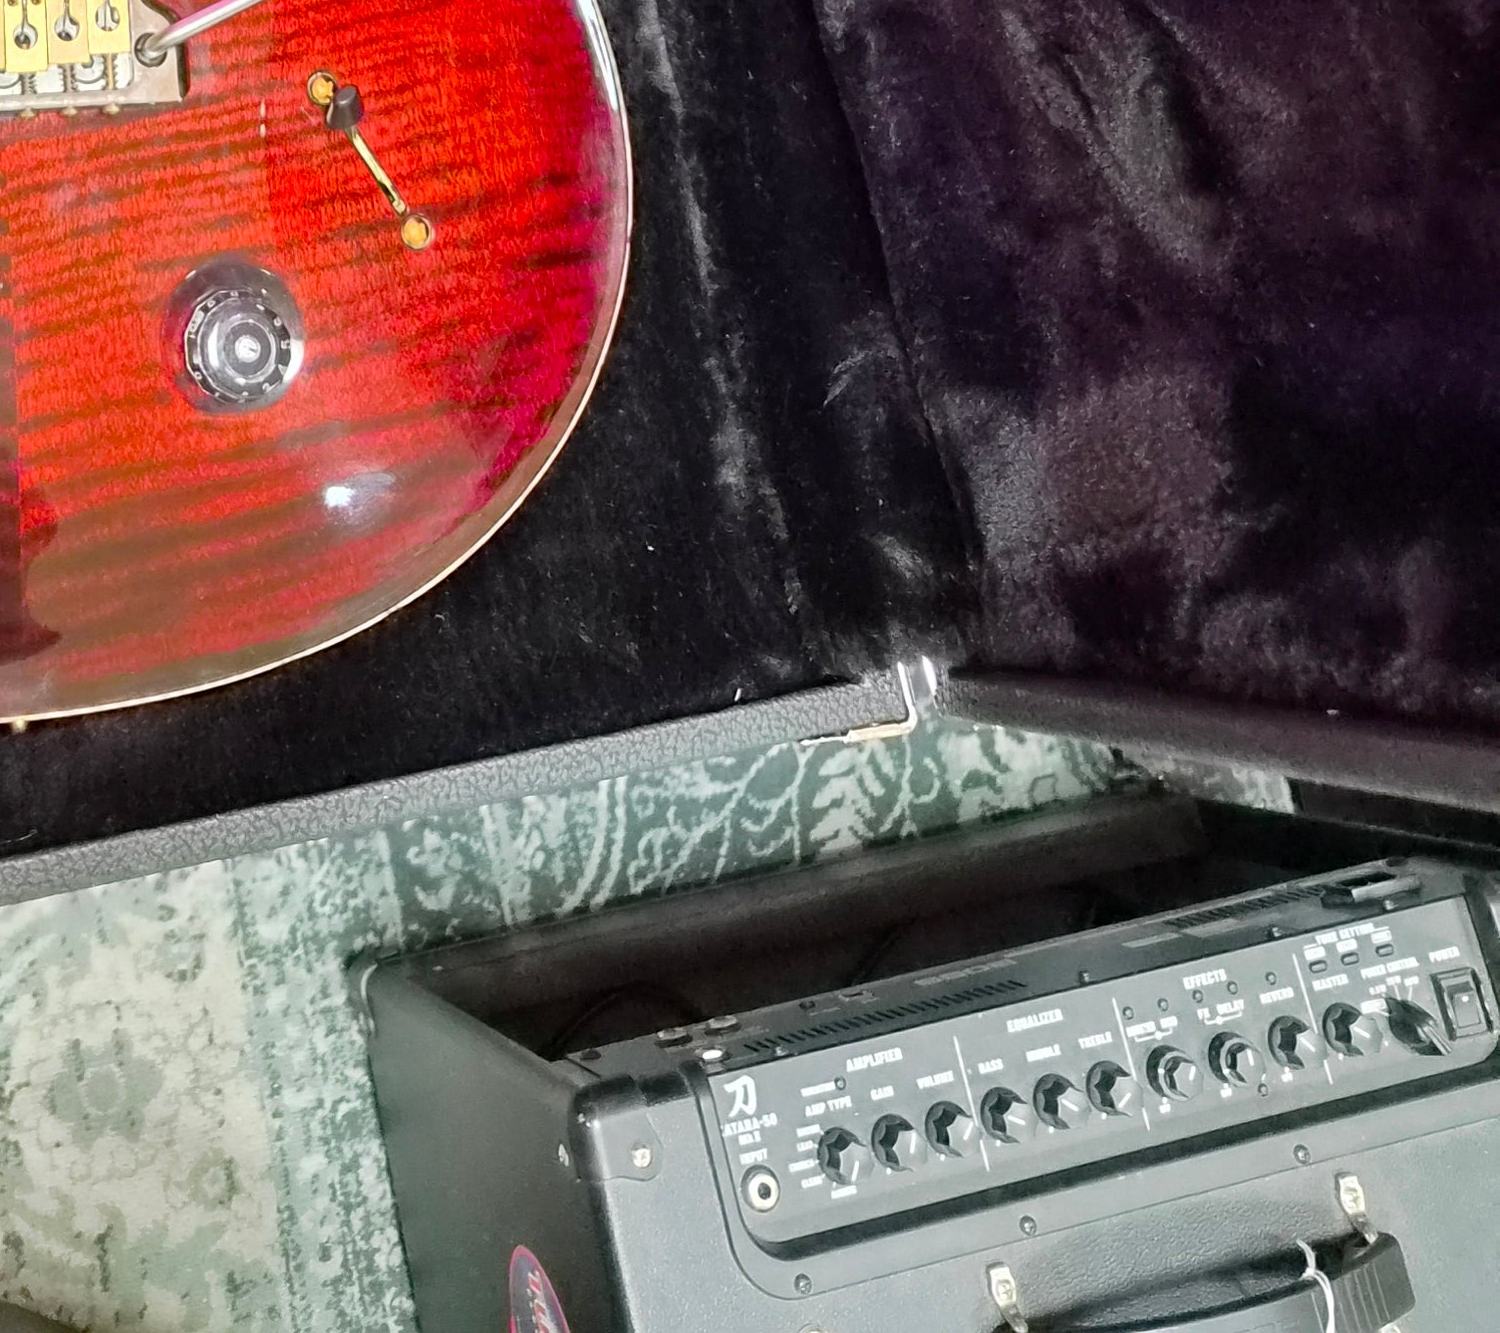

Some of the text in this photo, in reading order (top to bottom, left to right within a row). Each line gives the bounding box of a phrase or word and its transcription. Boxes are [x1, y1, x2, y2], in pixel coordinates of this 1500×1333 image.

[1183, 968, 1228, 991] EFFECTS
[1216, 998, 1245, 1015] DELAY
[1006, 1007, 1064, 1033] EQUALIZER
[1077, 1031, 1113, 1050] TREBLE
[845, 1046, 903, 1073] AMPLIFIER
[978, 1058, 1004, 1075] BASS
